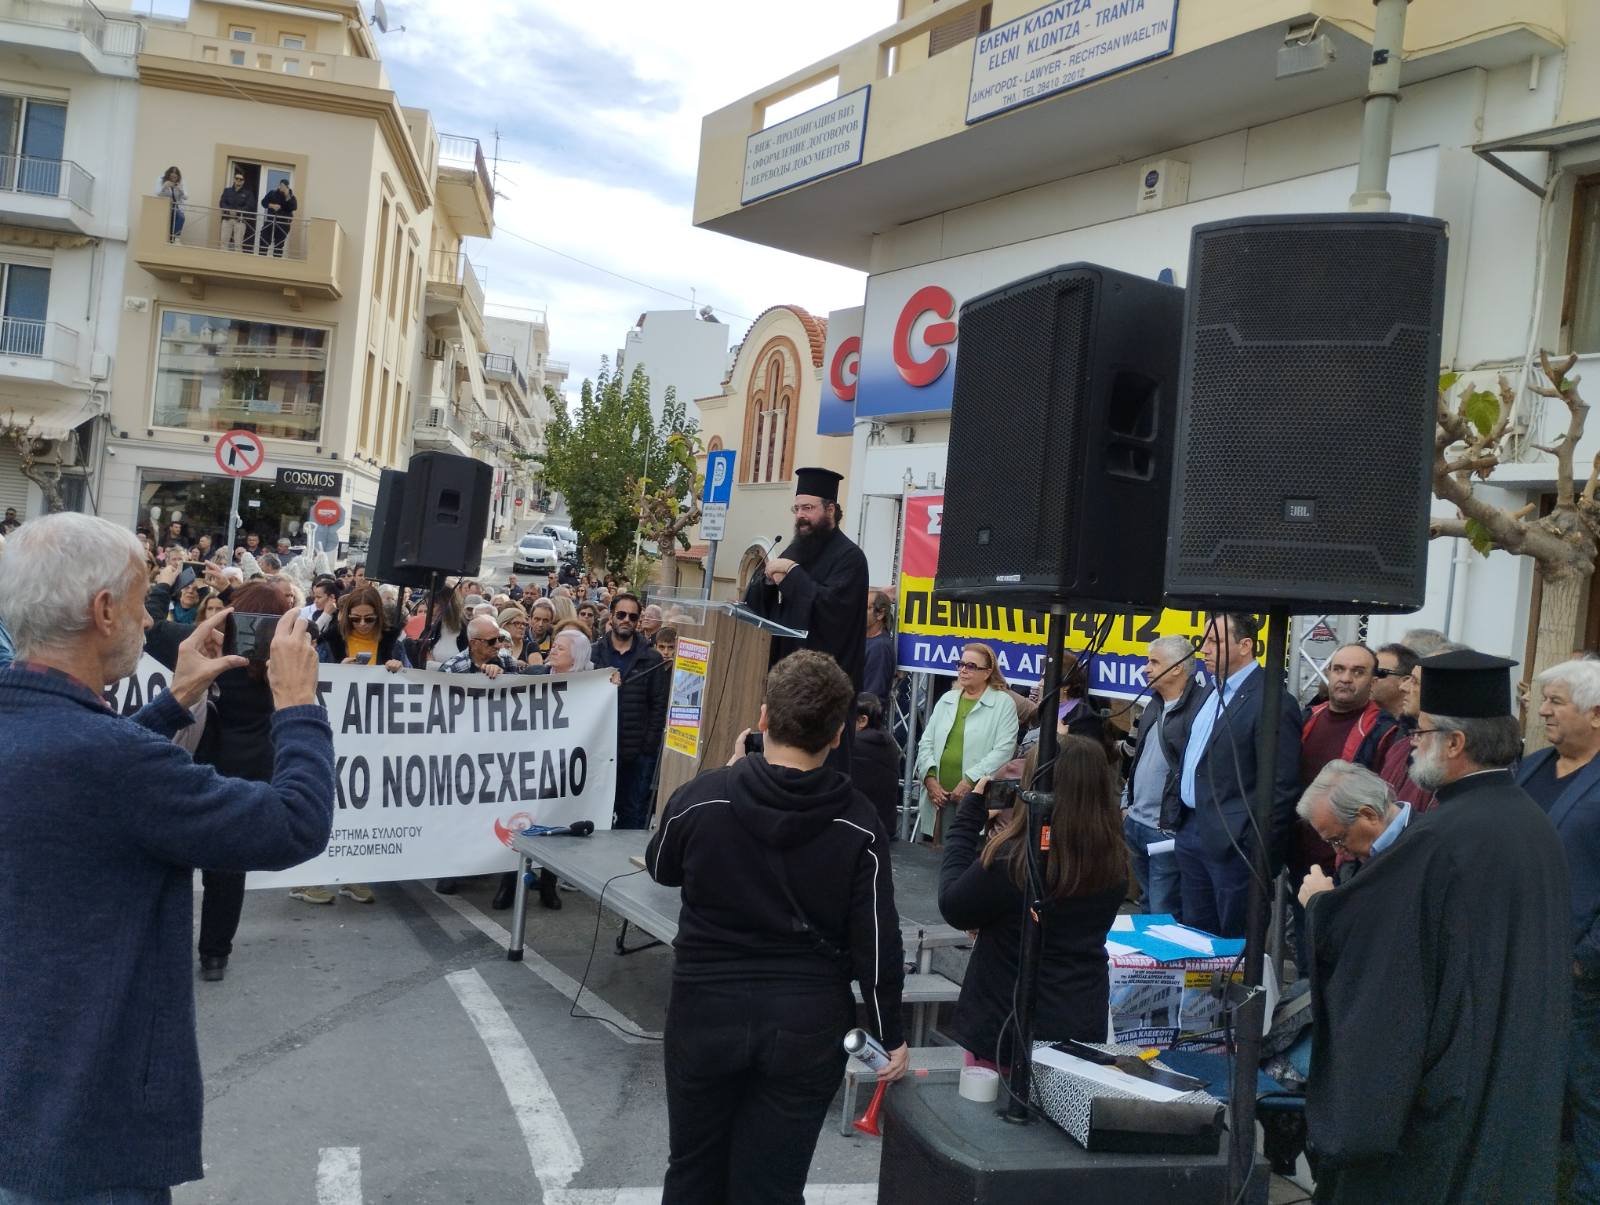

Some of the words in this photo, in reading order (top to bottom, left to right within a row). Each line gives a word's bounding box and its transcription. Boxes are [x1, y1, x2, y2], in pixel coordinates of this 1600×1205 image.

[980, 24, 1020, 55] ΕΛΕΝΗ
[1024, 0, 1092, 36] ΚΛΩΝΤΖΑ
[988, 45, 1020, 71] ELENI
[1027, 20, 1080, 55] KLONTZA
[1096, 0, 1145, 28] TRANTA
[971, 76, 1019, 104] ΔΙΚΗΓΟΡΟΣ
[1025, 60, 1061, 83] LAWYER
[837, 105, 855, 120] ВИЗ
[806, 120, 859, 151] ДОГОВОРОВ
[750, 164, 791, 186] ПЕРЕВОДЫ
[791, 140, 850, 171] ДОКУМЕНТОВ
[283, 470, 335, 487] COSMOS
[1290, 505, 1310, 517] JBL
[341, 681, 569, 735] ΑΠΕΞΑΡΤΗΣΗΣ
[382, 746, 587, 808] ΝΟΜΟΣΧΕΔΙΟ
[328, 843, 403, 857] ΕΡΓΑΖΟΜΕΝΩΝ
[372, 826, 423, 840] ΣΥΛΛΟΓΟΥ
